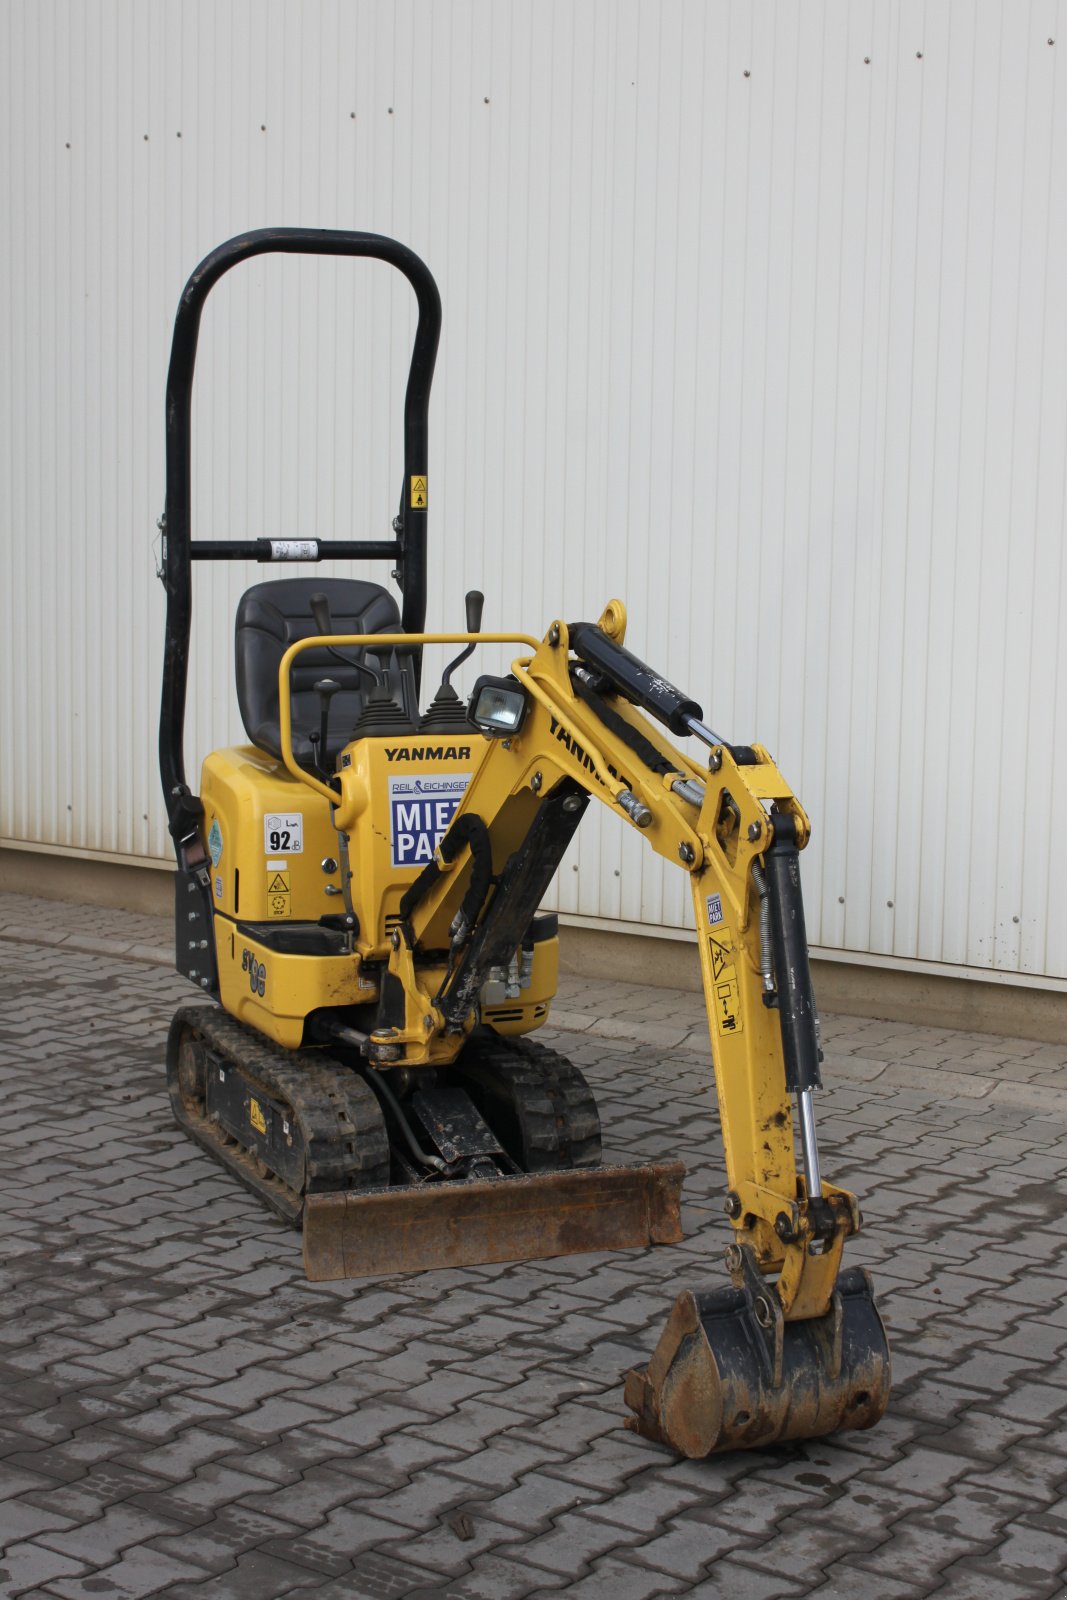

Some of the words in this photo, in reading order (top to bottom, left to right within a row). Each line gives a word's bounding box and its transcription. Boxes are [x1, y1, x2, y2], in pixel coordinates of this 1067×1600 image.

[384, 746, 471, 761] YANMAR
[392, 783, 413, 791] REIL
[270, 831, 291, 851] 92
[291, 840, 301, 851] dB
[708, 901, 721, 913] MIET
[709, 911, 723, 924] PARK
